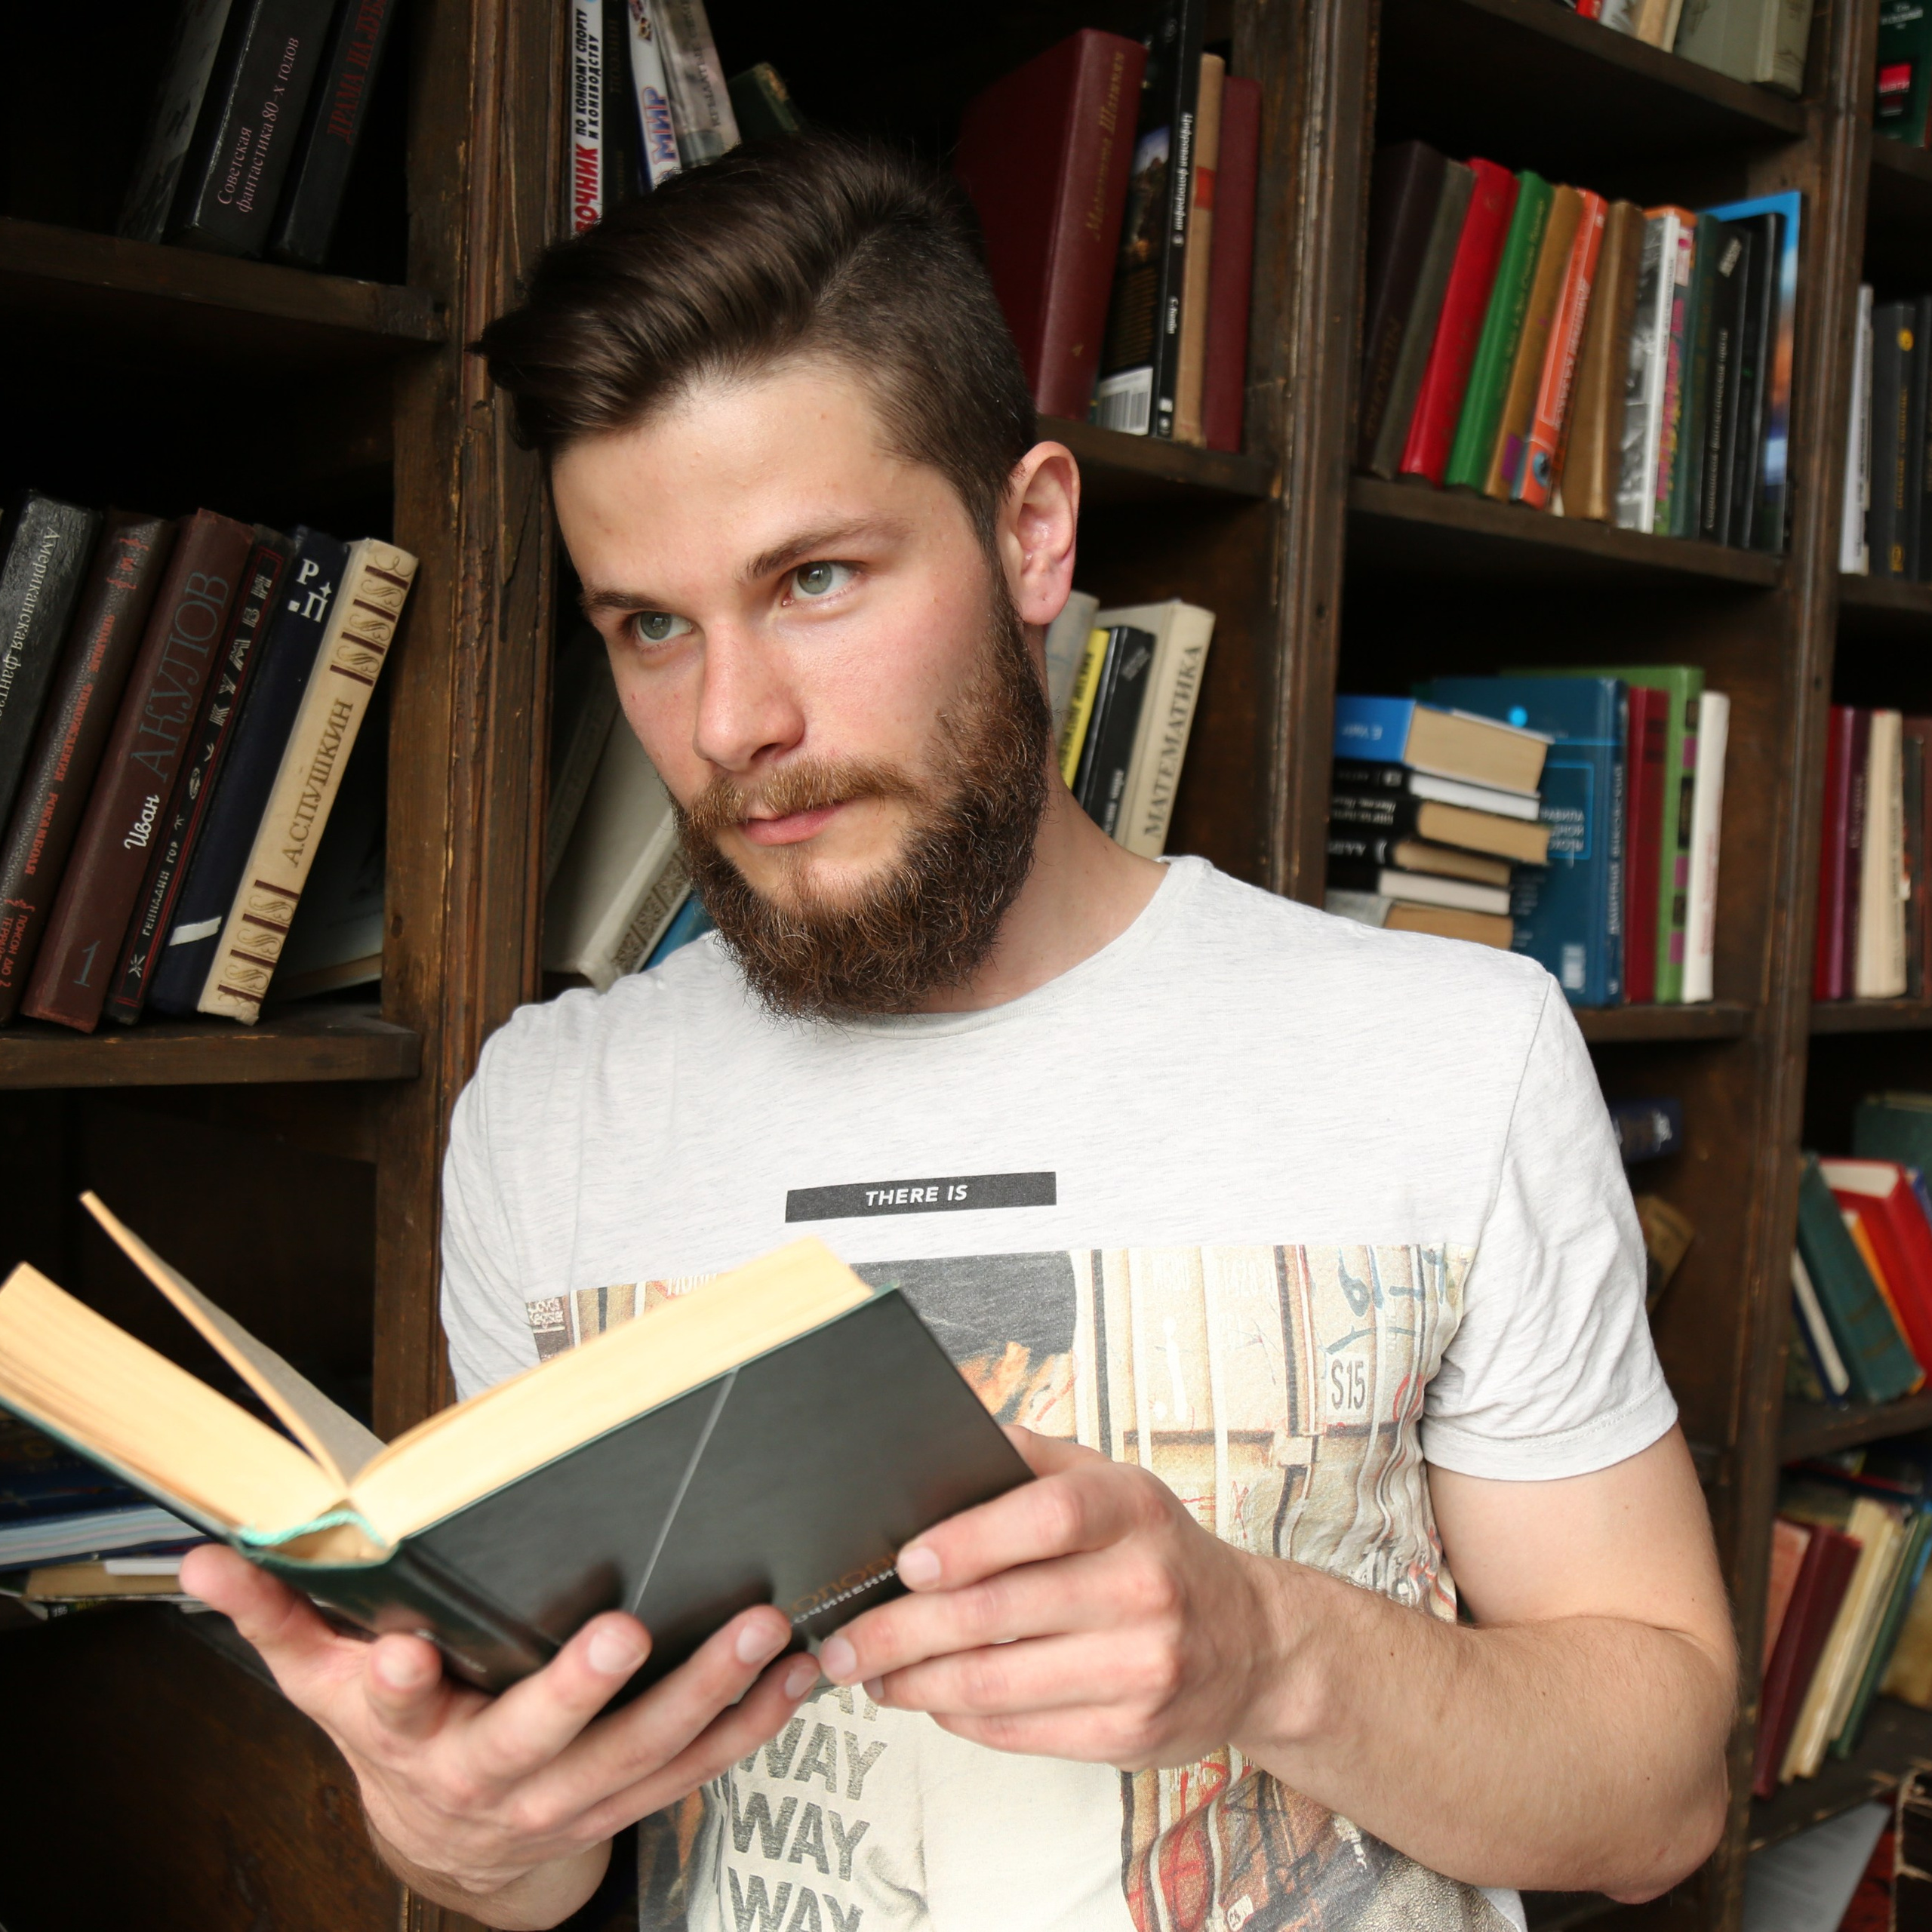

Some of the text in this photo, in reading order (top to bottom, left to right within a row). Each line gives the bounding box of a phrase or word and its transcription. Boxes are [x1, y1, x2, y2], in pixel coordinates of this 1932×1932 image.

[326, 73, 365, 146] ДРАМА
[576, 9, 588, 137] ПО КОННОМУ СПОРТУ
[589, 35, 601, 140] И КОНЕВОДСТВУ
[238, 38, 299, 214] фантастика 80-х годов
[643, 86, 677, 165] МИР
[217, 127, 252, 205] Советская
[575, 143, 598, 233] ВОЧНИК
[0, 526, 60, 717] Американская фанта
[124, 571, 230, 850] Иван АКУЛОВ
[1143, 645, 1202, 839] МАТЕМАТИКА
[25, 792, 59, 875] РОКАМБОЛЯ
[167, 841, 178, 863] ГОР
[1540, 808, 1585, 822] РАВИЛА
[8, 915, 29, 955] ПОНСОН
[73, 940, 101, 988] 1
[866, 1184, 969, 1208] THERE IS
[1331, 1358, 1366, 1410] S15
[792, 1565, 899, 1624] ОЧИНЕНИ
[738, 1717, 888, 1801] WAY
[731, 1783, 871, 1882] WAY
[728, 1866, 864, 1932] WAY
